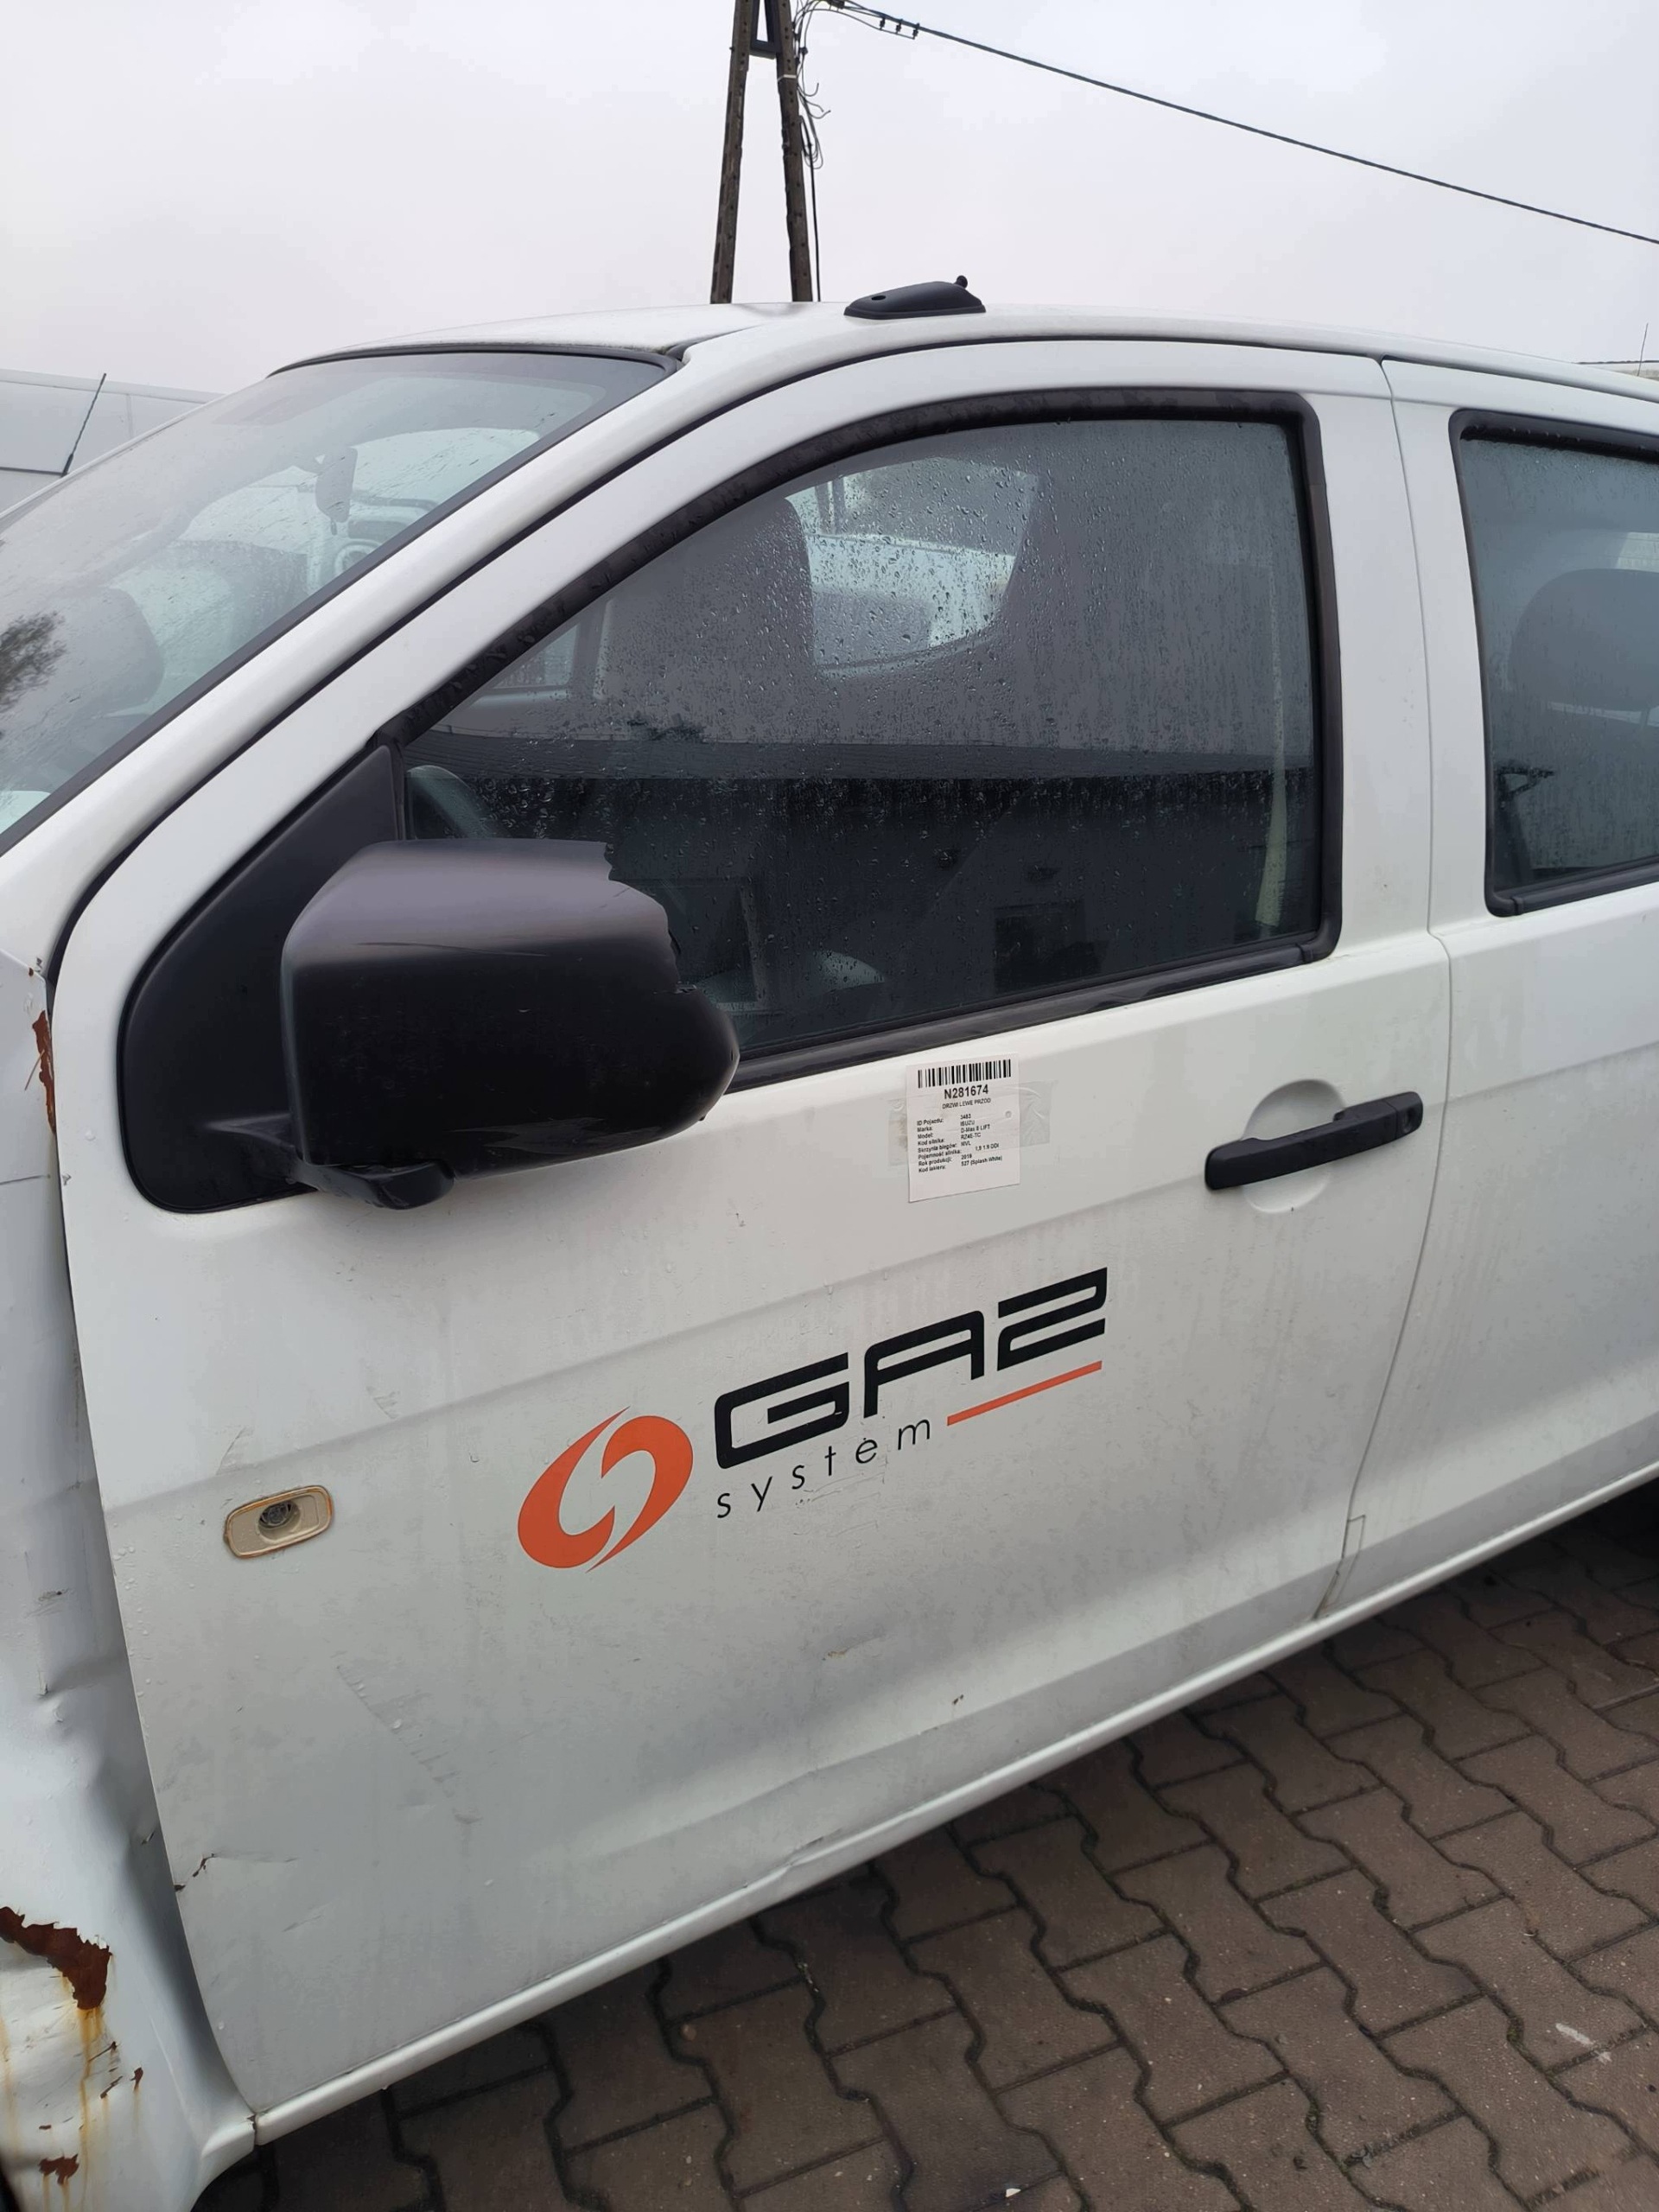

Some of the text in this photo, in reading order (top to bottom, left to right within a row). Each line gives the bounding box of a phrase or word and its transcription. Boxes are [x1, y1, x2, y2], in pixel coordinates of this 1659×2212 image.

[944, 1084, 988, 1099] N281674
[715, 1267, 1107, 1468] GAZ
[716, 1418, 931, 1518] system
